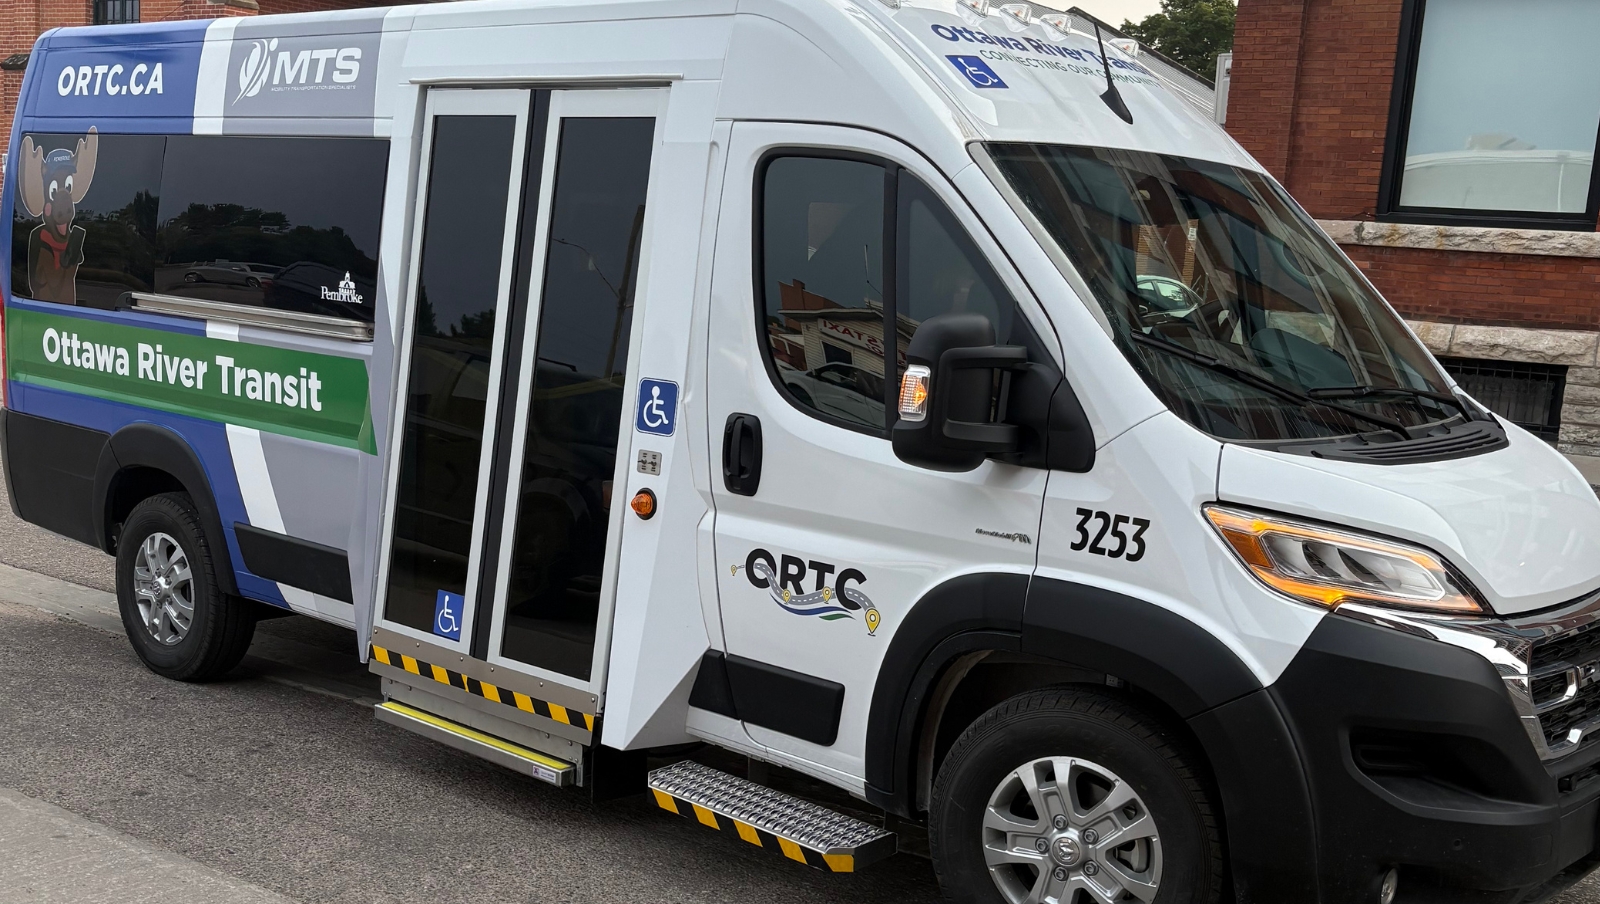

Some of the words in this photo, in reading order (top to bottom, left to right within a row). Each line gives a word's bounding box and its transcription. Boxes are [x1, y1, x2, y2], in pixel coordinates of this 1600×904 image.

[931, 24, 1029, 52] Ottawa
[1022, 36, 1088, 62] River
[57, 62, 164, 96] ORTC.CA
[272, 47, 362, 85] MTS
[979, 49, 1067, 72] CONNECTING
[1067, 64, 1097, 77] OUR
[1095, 69, 1164, 90] CMMUNITY
[321, 285, 363, 304] Pembroke
[42, 327, 130, 376] Ottawa
[137, 343, 208, 390] River
[215, 355, 323, 411] Transit
[1070, 507, 1151, 562] 3253
[745, 548, 867, 611] ORTC
